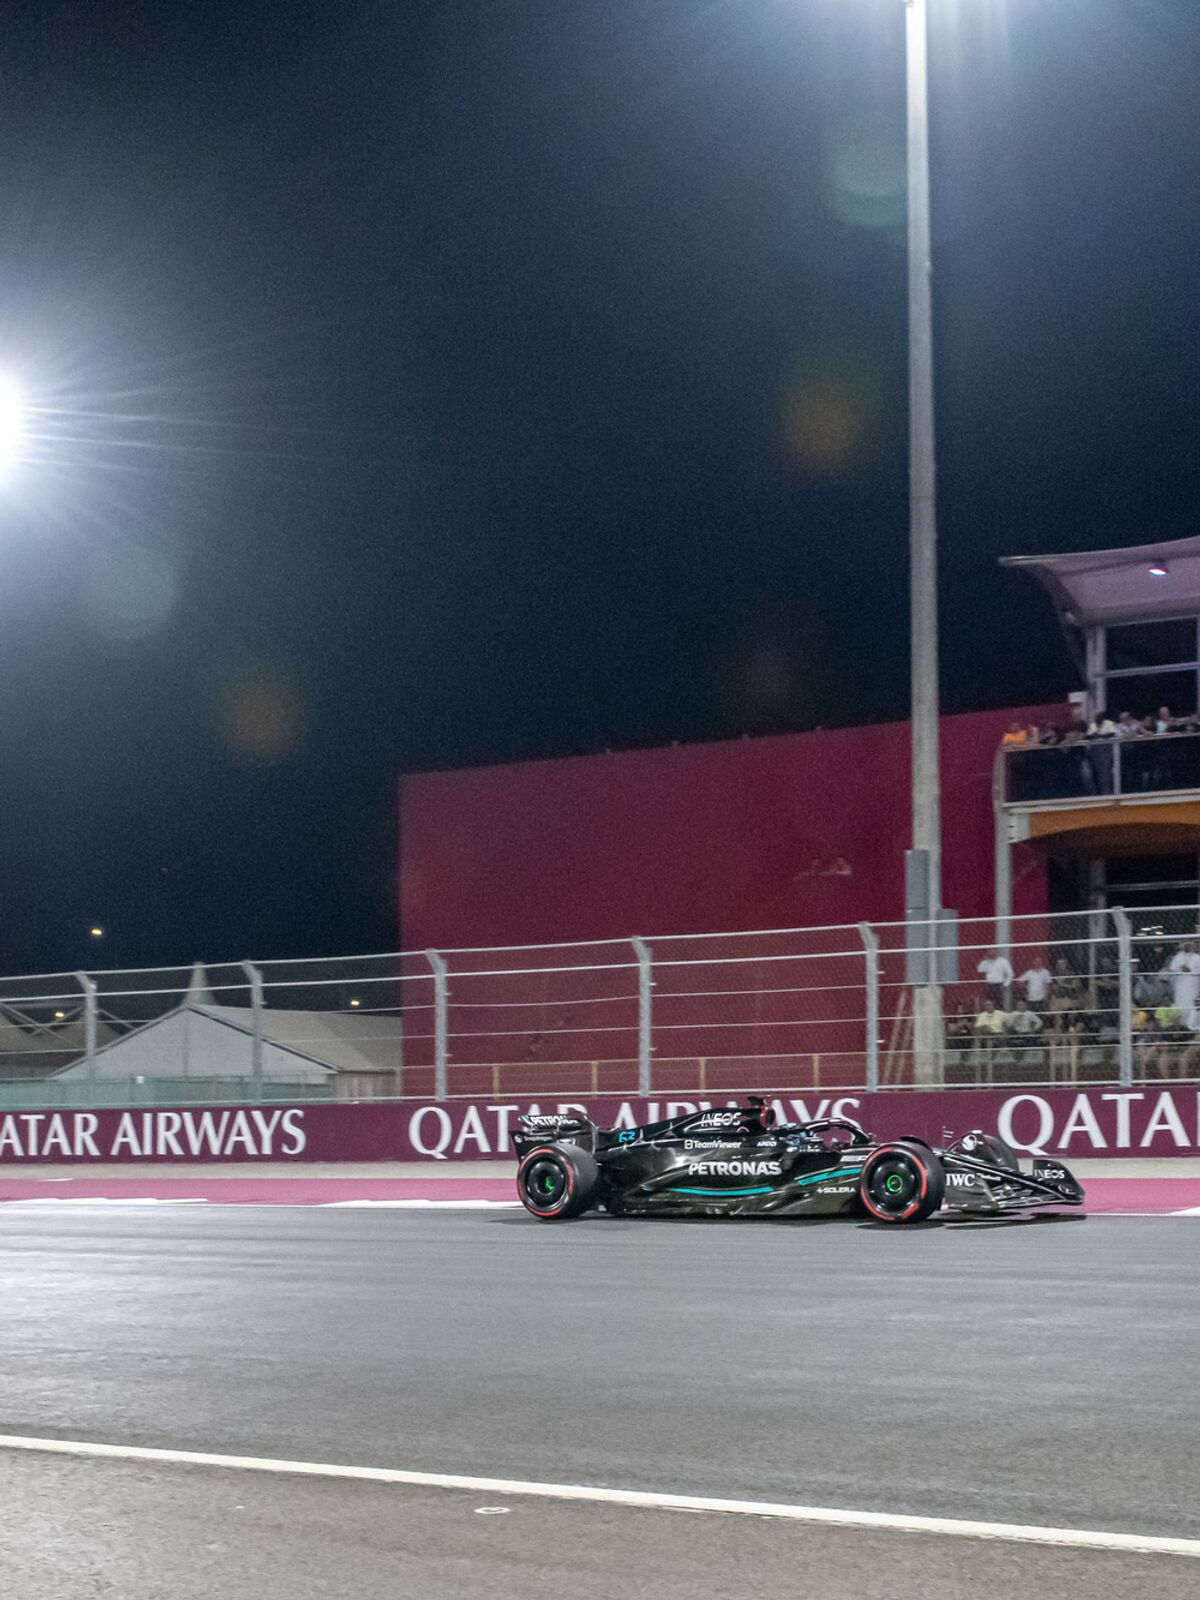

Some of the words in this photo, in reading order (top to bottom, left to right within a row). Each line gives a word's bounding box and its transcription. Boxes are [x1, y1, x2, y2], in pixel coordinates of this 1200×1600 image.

[701, 1112, 742, 1127] INEOS
[110, 1109, 306, 1156] AIRWAYS
[408, 1104, 588, 1160] QAT
[693, 1139, 743, 1149] TeamViewer
[688, 1161, 783, 1176] PETRONAS
[1034, 1169, 1065, 1181] INEOS
[945, 1173, 976, 1187] IWC
